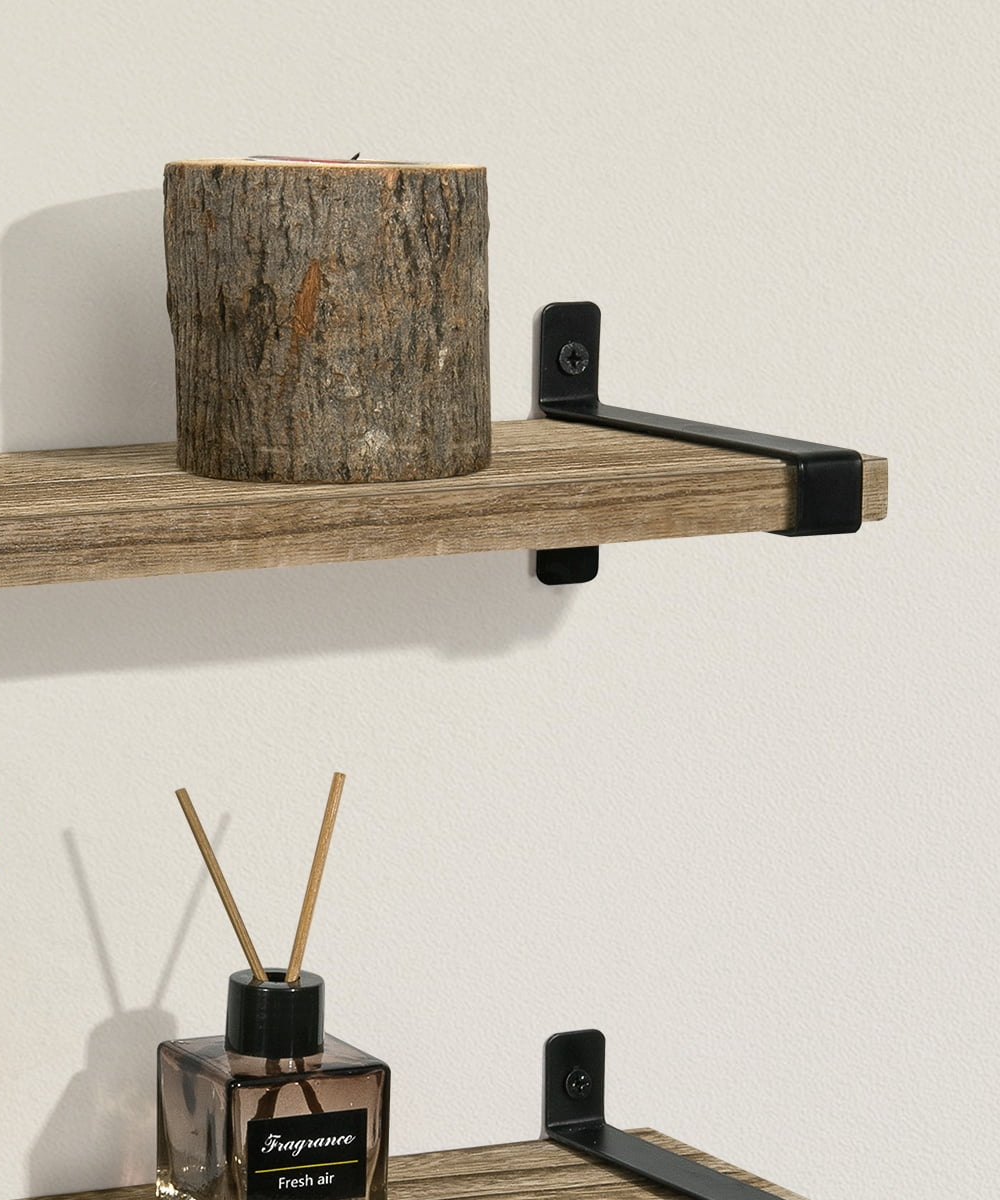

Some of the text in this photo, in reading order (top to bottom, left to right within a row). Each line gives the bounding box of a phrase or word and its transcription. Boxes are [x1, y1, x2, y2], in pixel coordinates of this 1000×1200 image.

[261, 1134, 356, 1157] Fragrance
[278, 1172, 335, 1190] Fresh air
